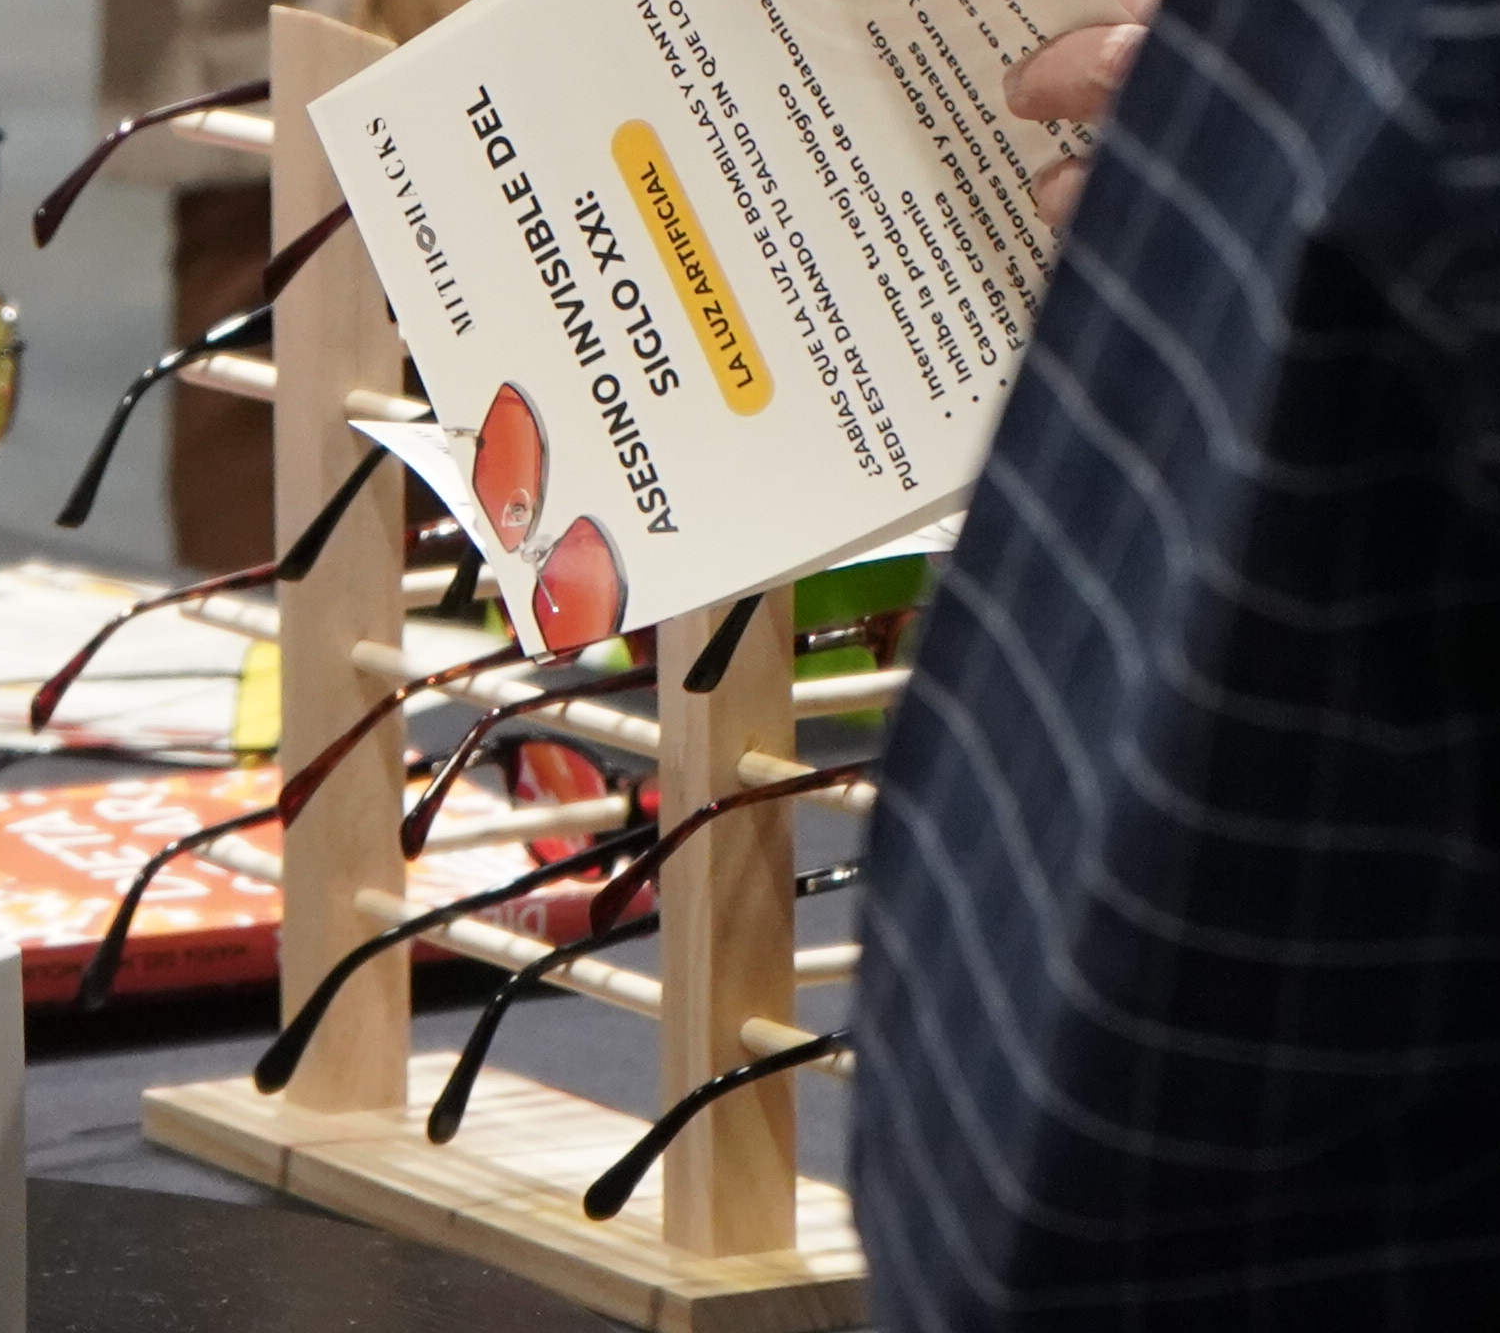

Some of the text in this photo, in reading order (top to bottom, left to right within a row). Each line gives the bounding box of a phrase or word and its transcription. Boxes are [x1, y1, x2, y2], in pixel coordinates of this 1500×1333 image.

[684, 30, 716, 77] QUE
[917, 10, 997, 125] prematuro
[978, 21, 999, 48] en
[679, 83, 694, 98] Y
[711, 80, 738, 118] SIN
[866, 20, 935, 129] depresión
[908, 41, 991, 174] hormonales
[689, 98, 761, 224] BOMBILLAS
[733, 121, 778, 194] SALUD
[832, 123, 852, 151] de
[932, 134, 950, 149] y
[770, 197, 793, 229] TU
[850, 155, 925, 281] producción
[934, 191, 984, 273] crónica
[940, 152, 1006, 252] ansiedad
[640, 160, 753, 388] LA LUZ ARTIFICIAL
[753, 226, 778, 259] DE
[778, 83, 945, 400] Interrumpe tu reloj biológico
[900, 190, 997, 366] Causa Insomnio
[466, 84, 678, 533] ASESINO INVISIBLE DEL
[574, 190, 679, 396] SIGLO XXI:
[770, 260, 800, 304] LUZ
[788, 230, 851, 343] DAÑANDO
[918, 284, 934, 309] la
[981, 277, 1031, 351] Fatiga
[794, 305, 815, 337] LA
[930, 311, 972, 383] Inhibe
[807, 338, 838, 386] QUE
[843, 345, 885, 415] ESTAR
[830, 389, 883, 476] ¿SABÍAS
[876, 416, 918, 491] PUEDE
